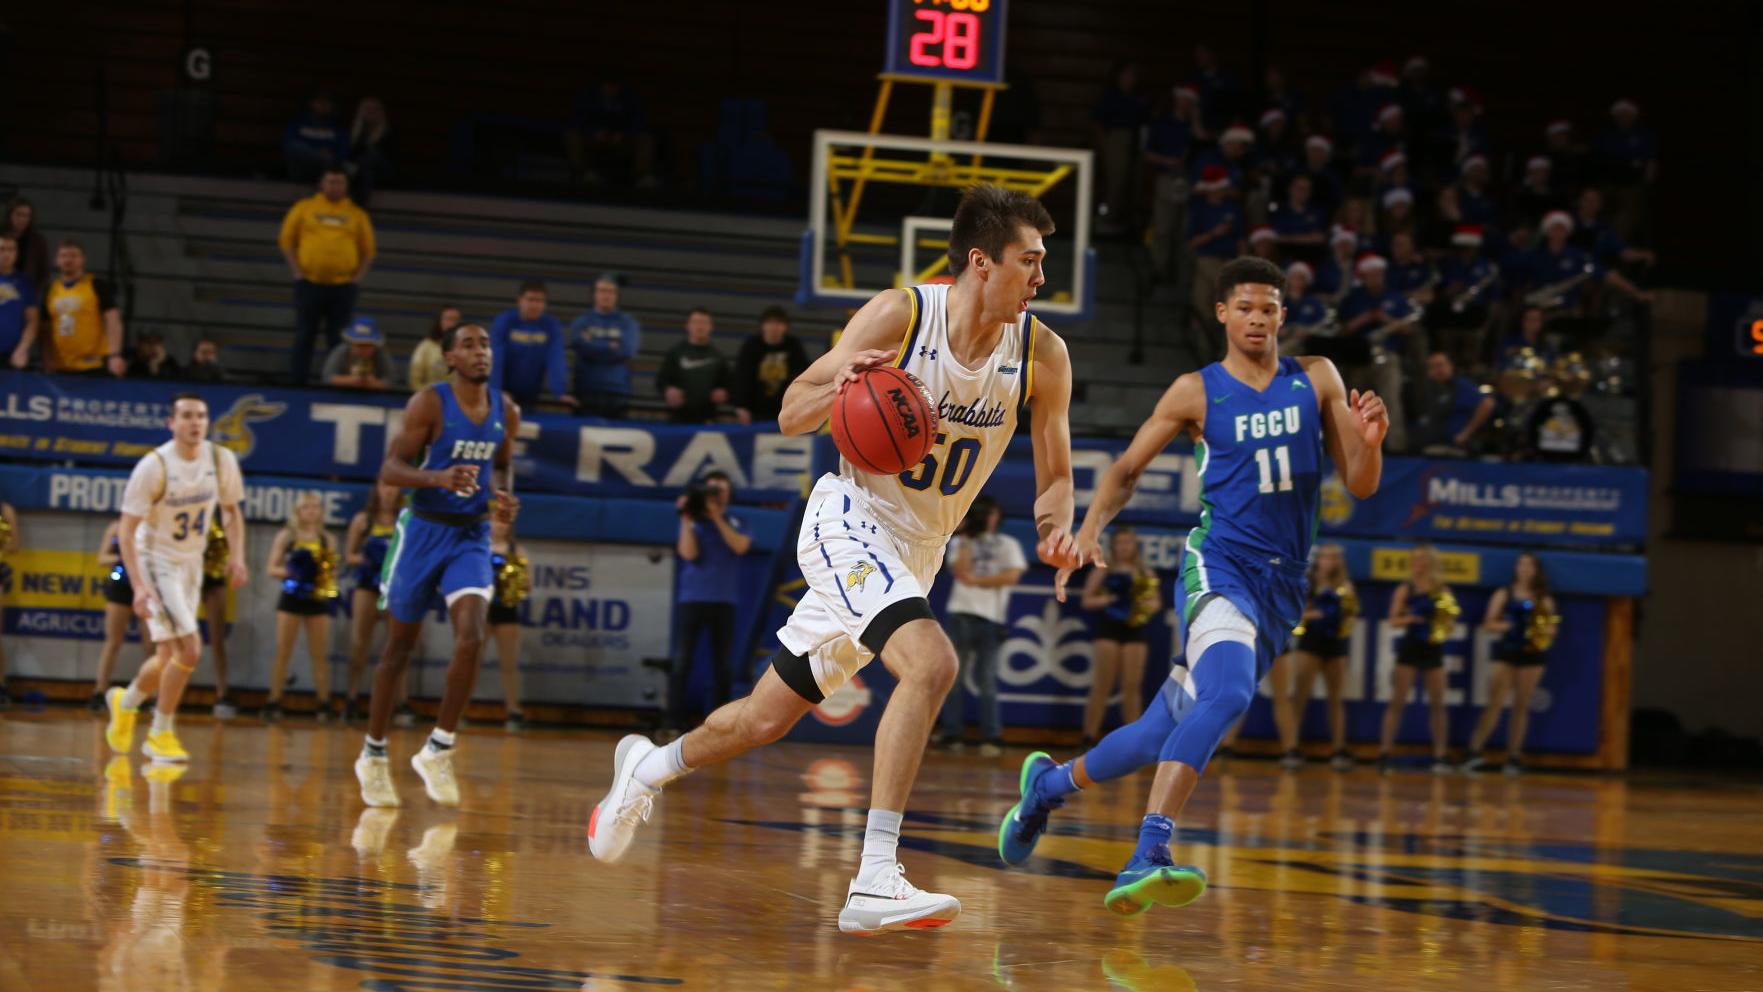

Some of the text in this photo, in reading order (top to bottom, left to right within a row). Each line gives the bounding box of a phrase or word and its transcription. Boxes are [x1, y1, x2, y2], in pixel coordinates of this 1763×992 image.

[910, 9, 979, 70] 28
[187, 49, 211, 80] G
[887, 388, 920, 439] NCAA
[938, 391, 1006, 428] krabbits
[1235, 405, 1301, 442] FGCU
[451, 439, 497, 460] FGCU
[575, 425, 813, 491] RAB
[898, 432, 982, 496] 50
[1255, 445, 1293, 494] 11
[49, 474, 129, 512] PROT
[1428, 477, 1520, 508] MILLS
[172, 508, 207, 541] 34
[22, 573, 83, 597] NEW
[533, 565, 590, 590] INS
[520, 596, 630, 632] LAND
